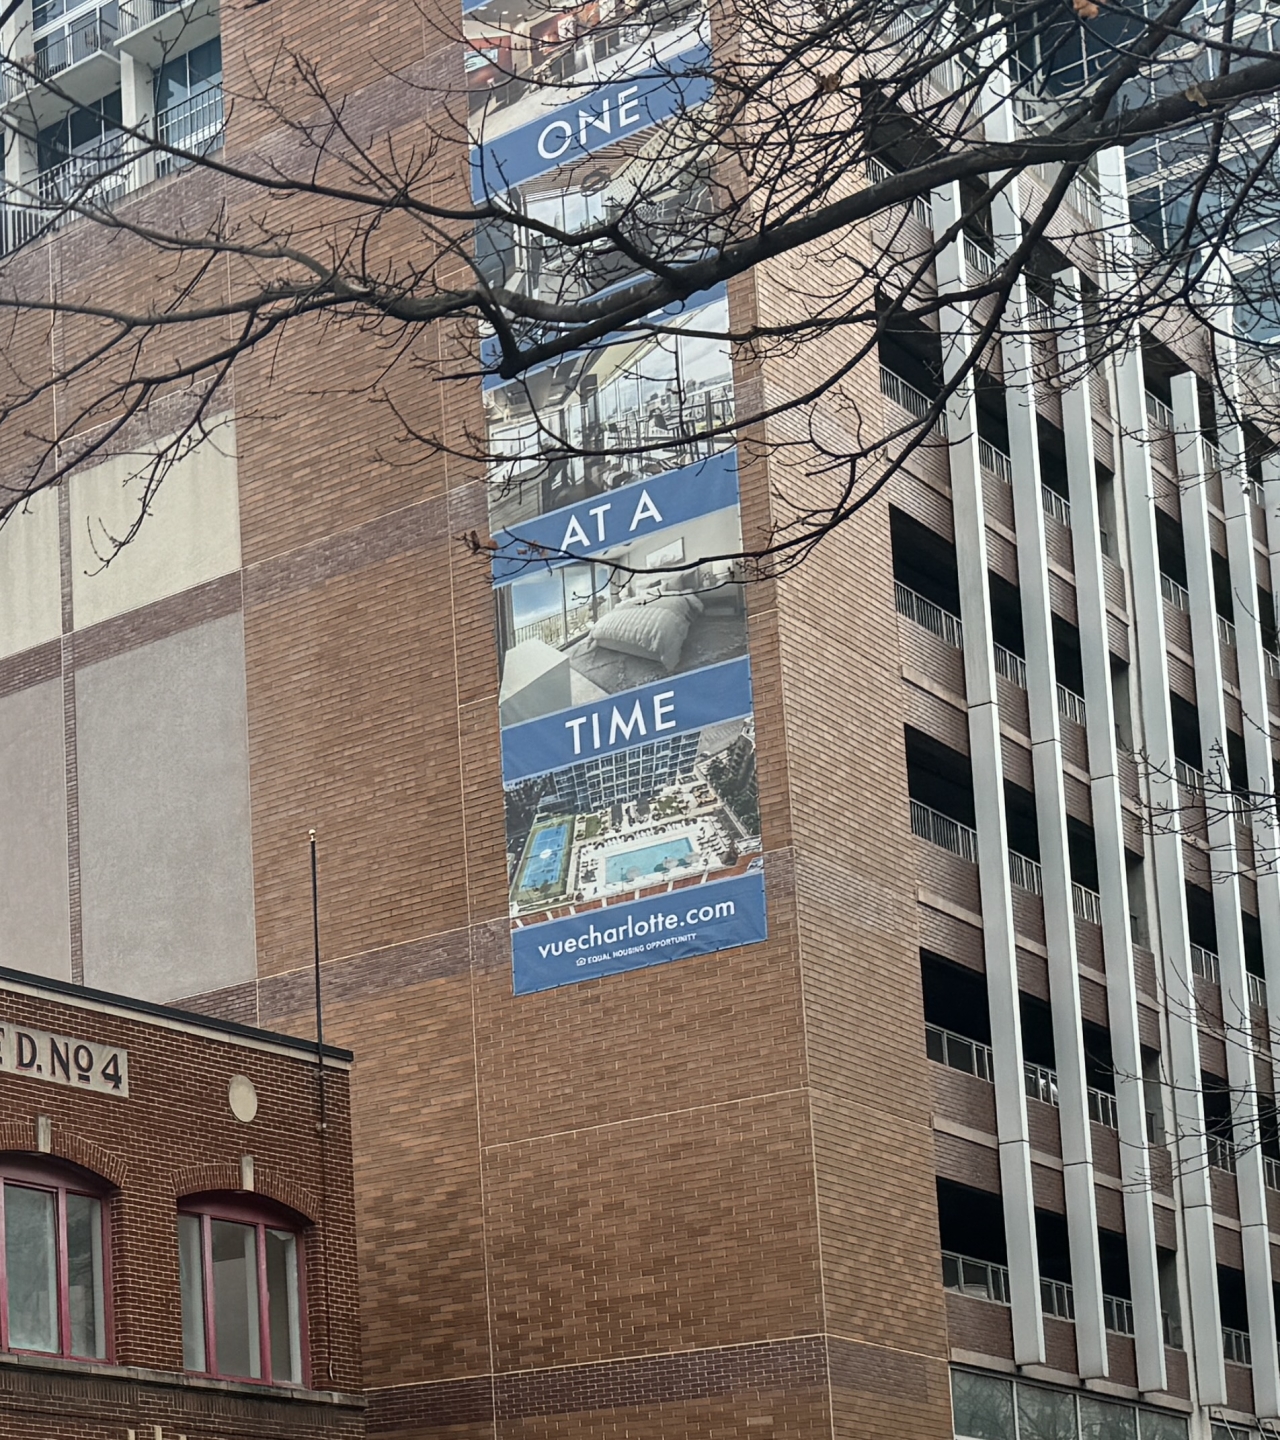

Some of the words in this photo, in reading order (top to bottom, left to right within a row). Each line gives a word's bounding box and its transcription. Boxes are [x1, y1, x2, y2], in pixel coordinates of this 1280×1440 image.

[537, 86, 640, 160] ONE
[558, 503, 611, 556] AT
[629, 489, 663, 532] A
[565, 690, 677, 755] TIME
[538, 900, 735, 959] vuecharlotte.com
[587, 951, 611, 965] EQUAL
[612, 944, 644, 959] HOUSING
[646, 932, 697, 951] OPPORTUNITY
